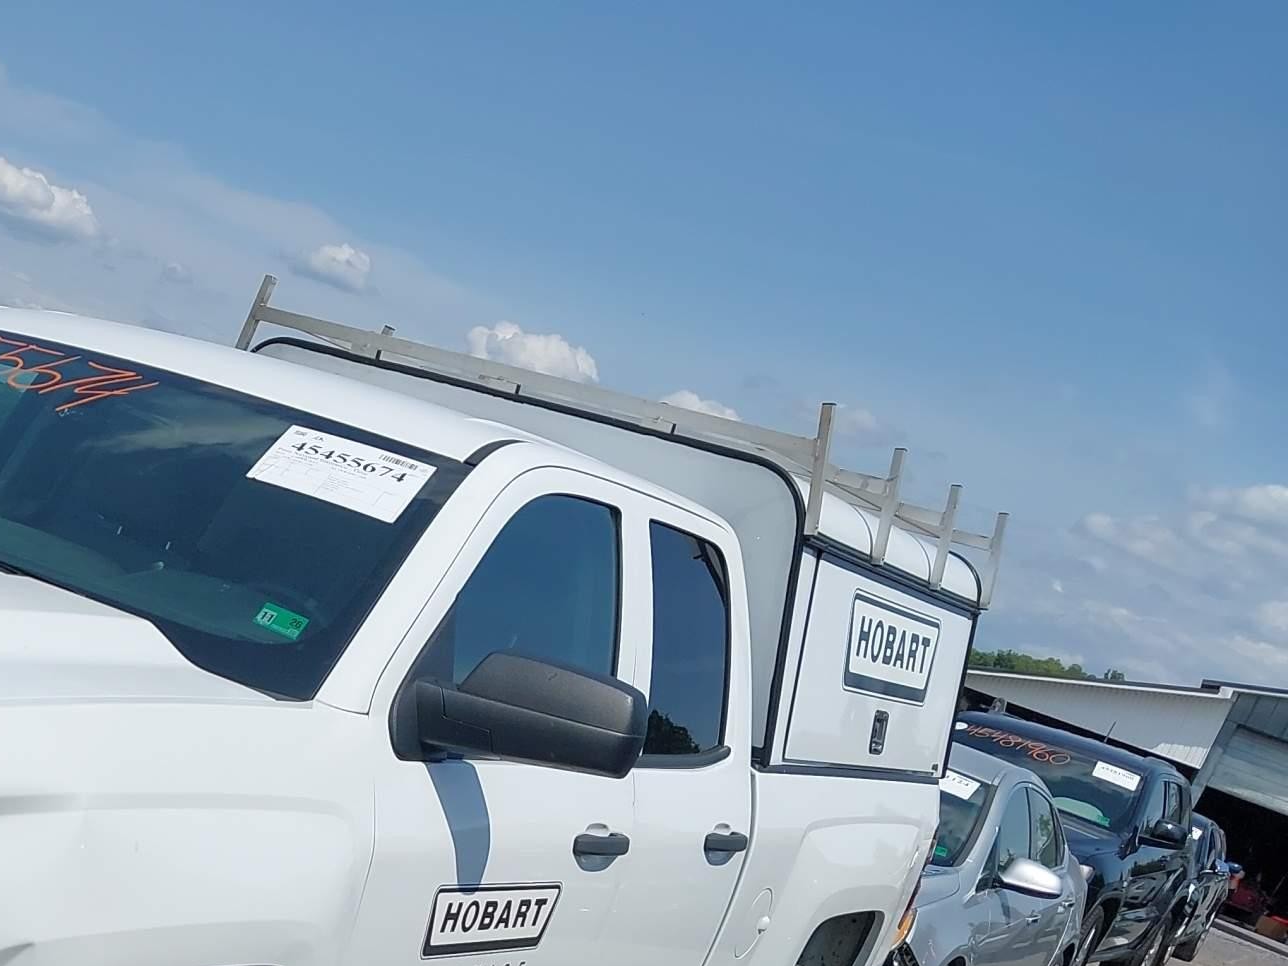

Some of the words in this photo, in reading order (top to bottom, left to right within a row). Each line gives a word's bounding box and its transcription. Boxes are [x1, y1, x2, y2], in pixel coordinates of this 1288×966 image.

[291, 441, 408, 483] 45455674
[855, 615, 932, 674] HOBART
[439, 898, 549, 933] HOBART
